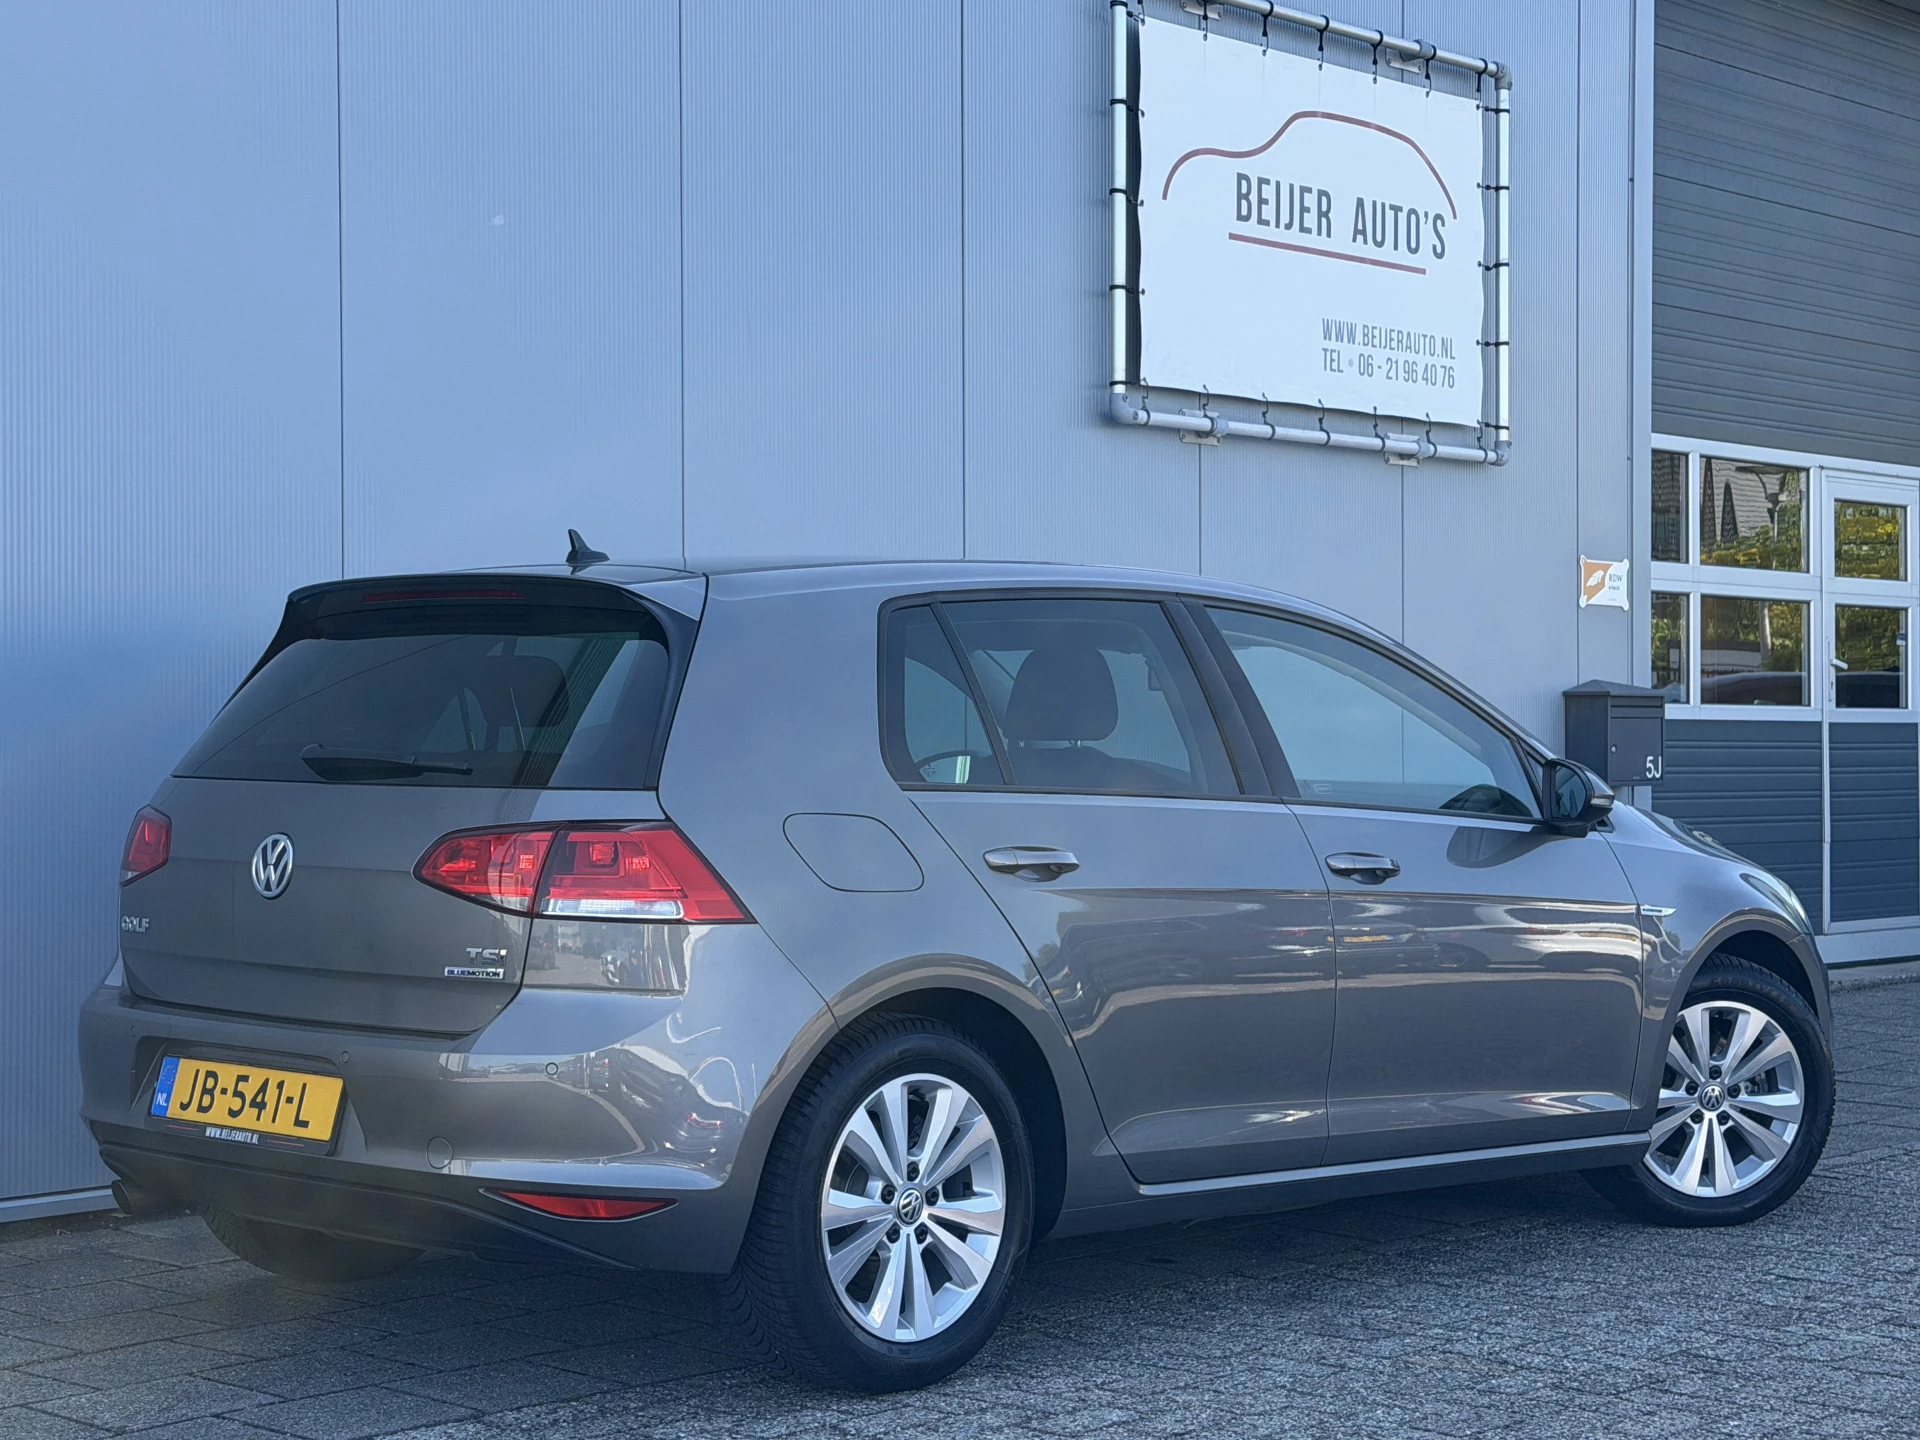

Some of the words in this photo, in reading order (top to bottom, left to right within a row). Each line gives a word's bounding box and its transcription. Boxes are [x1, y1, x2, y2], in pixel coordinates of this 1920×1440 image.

[1236, 171, 1332, 238] BEIJER
[1352, 196, 1446, 260] AUTO'S
[1322, 318, 1456, 360] WWW.BEIJERAUTO.NL
[1322, 347, 1344, 373] TEL
[1646, 756, 1662, 778] 5J
[121, 915, 150, 933] GOLF
[447, 969, 500, 977] BLUEMOTION
[157, 1092, 167, 1106] NL
[179, 1068, 310, 1128] JB-541-L
